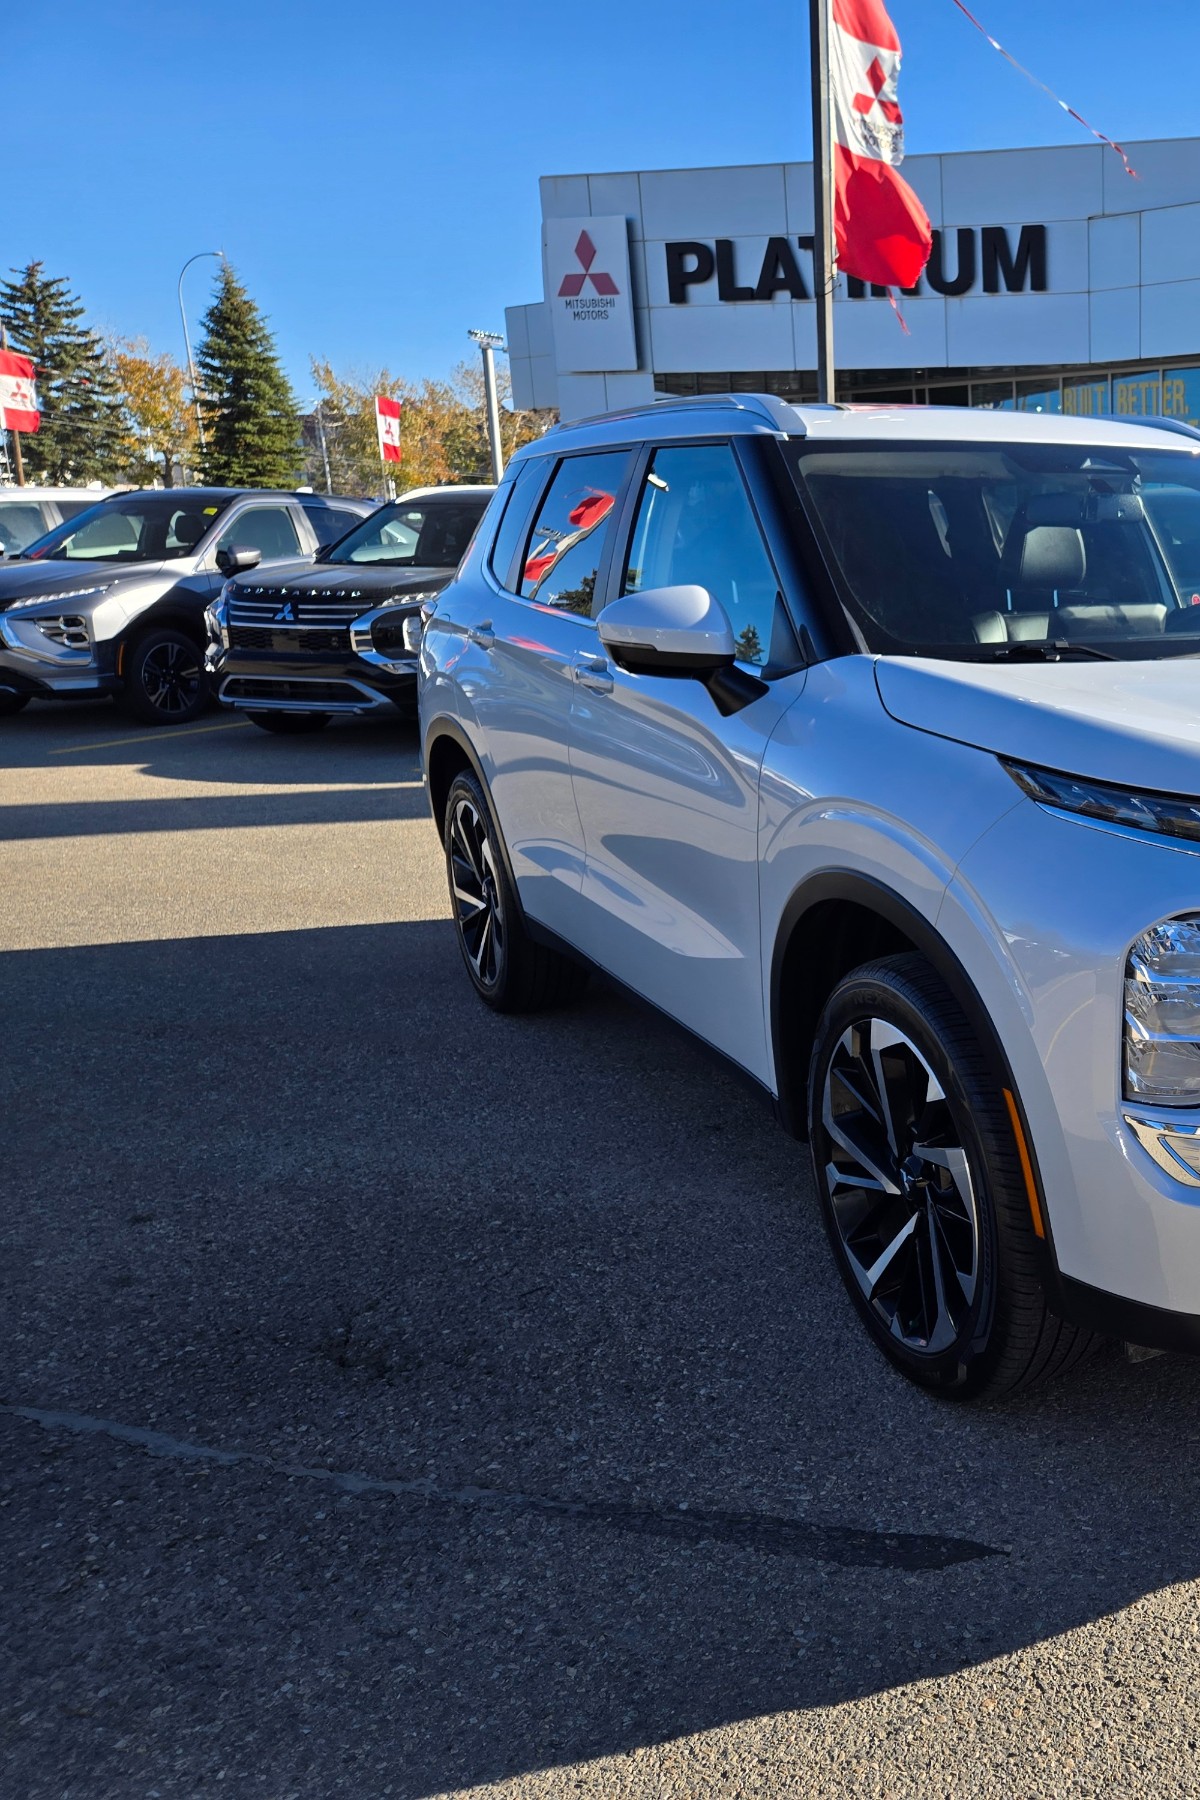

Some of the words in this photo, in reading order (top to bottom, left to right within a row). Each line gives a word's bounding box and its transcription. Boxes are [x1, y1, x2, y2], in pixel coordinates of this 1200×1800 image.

[665, 224, 1048, 304] PLAUM
[565, 298, 616, 309] MITSUBISHI
[573, 310, 609, 320] MOTORS
[1117, 379, 1189, 416] BETTER.
